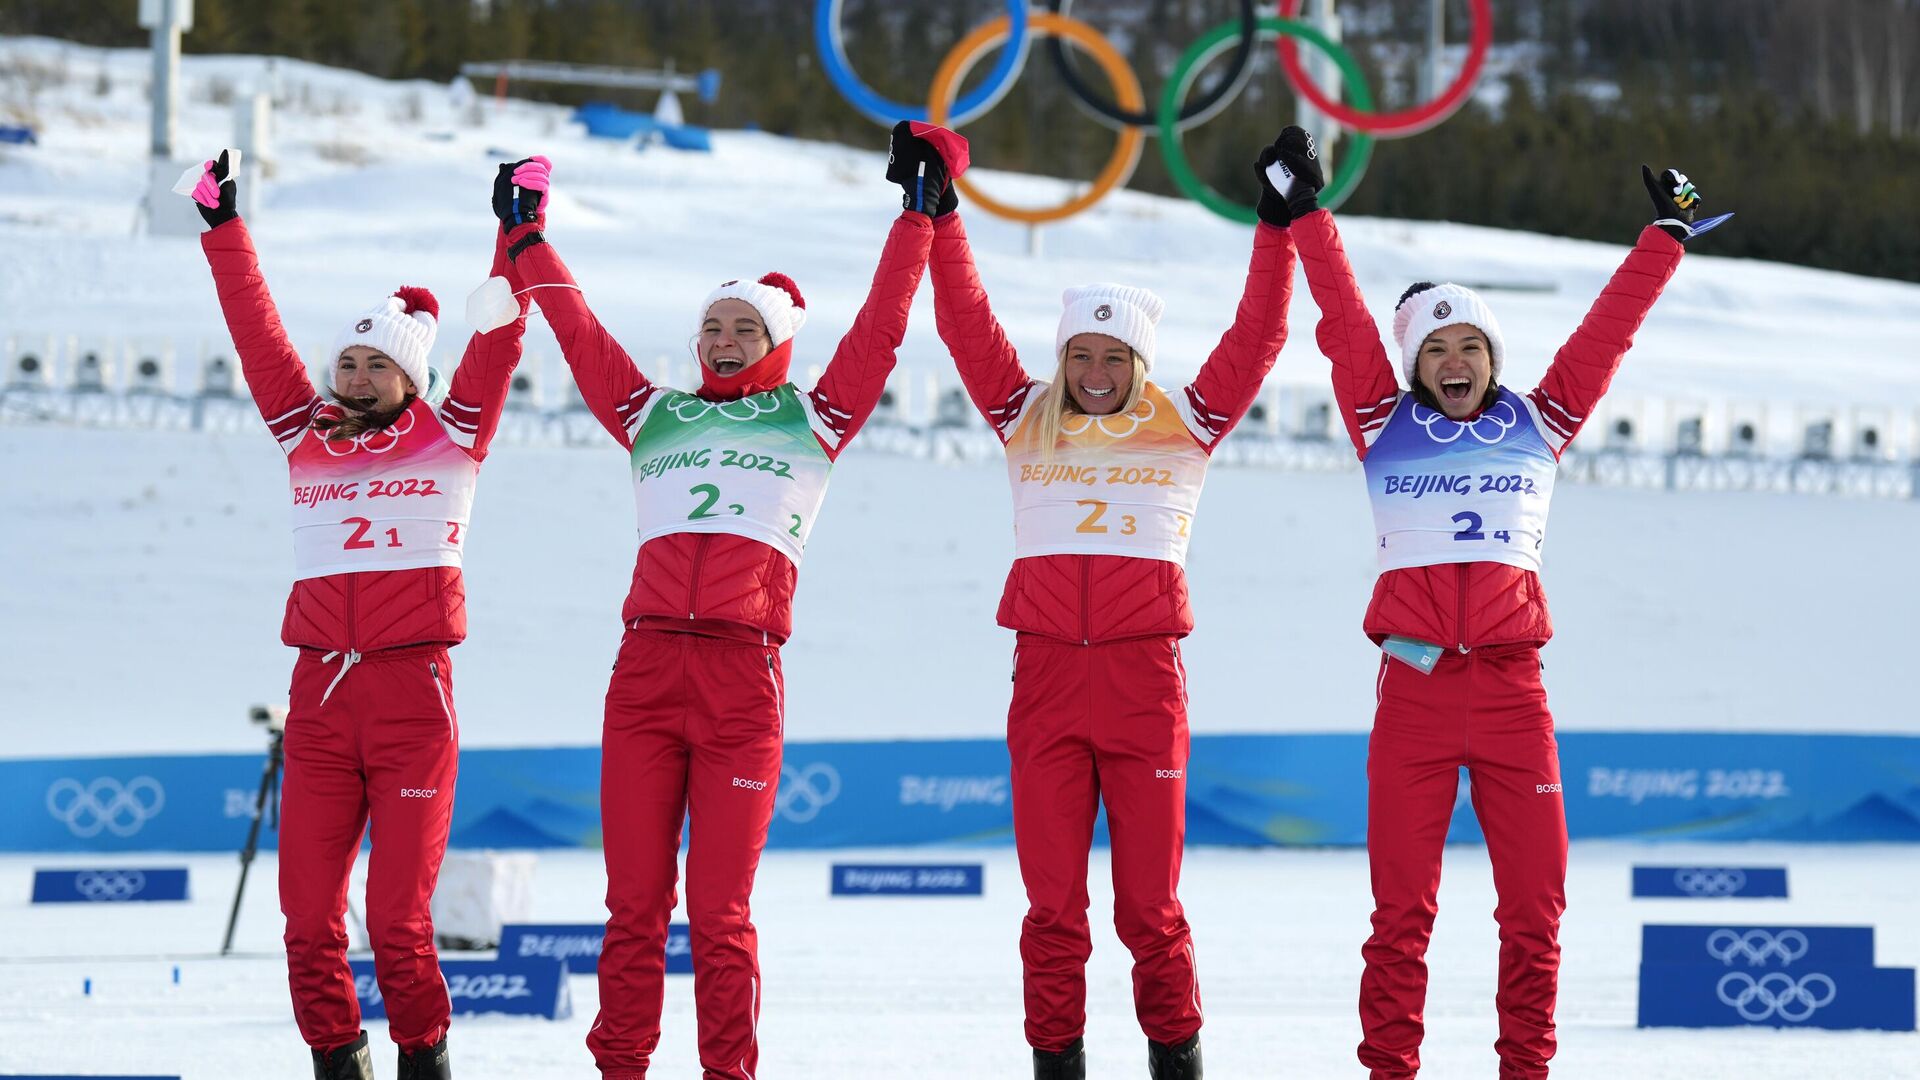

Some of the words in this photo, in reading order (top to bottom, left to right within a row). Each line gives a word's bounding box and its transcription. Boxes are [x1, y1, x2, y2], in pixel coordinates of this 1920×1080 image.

[639, 449, 712, 484] BEIJING
[720, 449, 796, 481] 2022
[1020, 464, 1098, 487] BEIJING
[1106, 466, 1177, 487] 2022
[293, 482, 360, 509] BEIJING
[366, 478, 444, 499] 2022
[687, 483, 721, 520] 2
[1384, 475, 1471, 499] BEIJING
[1479, 475, 1538, 496] 2022
[788, 514, 802, 538] 2
[1075, 499, 1108, 534] 2
[1120, 515, 1137, 535] 3
[1451, 510, 1485, 541] 2
[340, 516, 375, 550] 2
[385, 527, 403, 548] 1
[446, 521, 460, 545] 2
[400, 788, 434, 799] BOSCO
[732, 777, 764, 791] BOSCO
[900, 775, 1007, 811] BEIJING
[1589, 767, 1698, 805] BEIJING
[1705, 768, 1790, 799] 2022
[518, 934, 603, 961] BEIJIN
[449, 973, 534, 999] 2022
